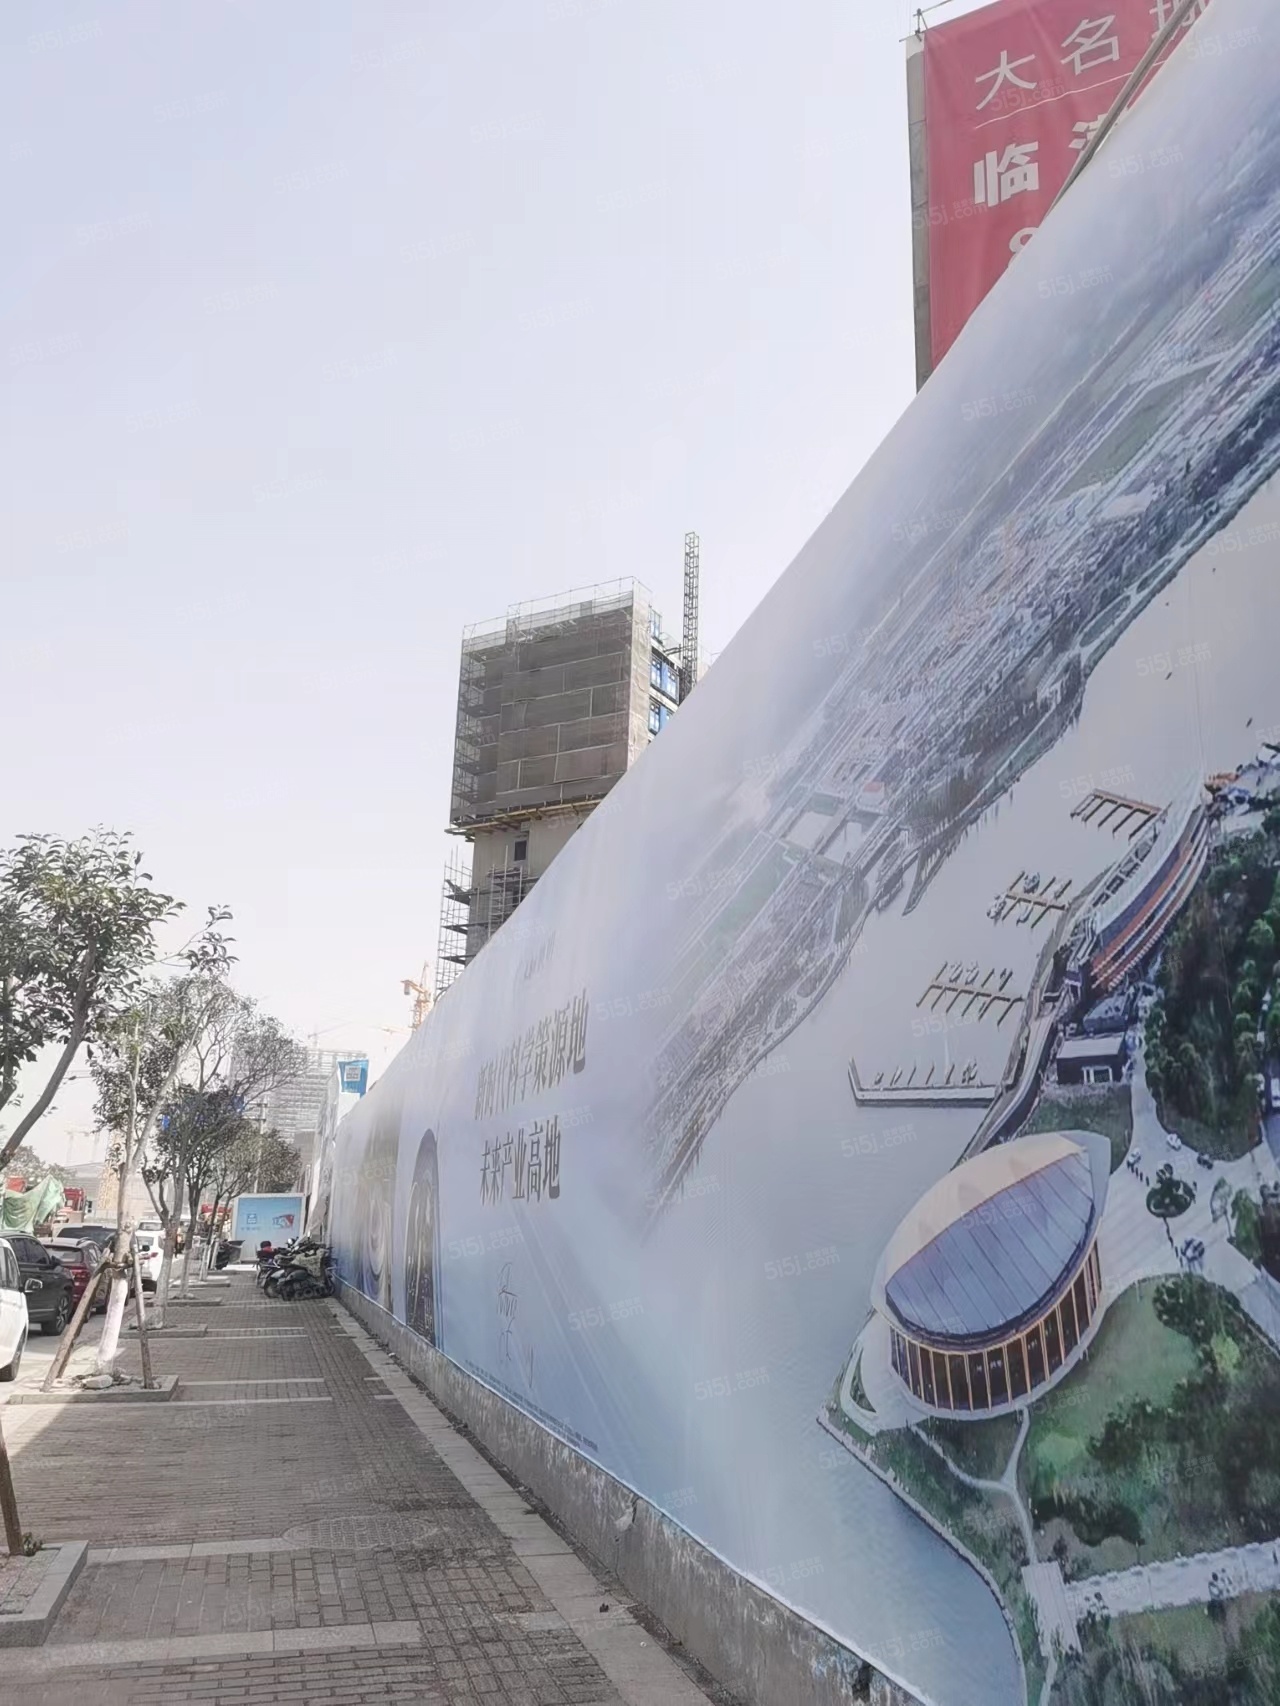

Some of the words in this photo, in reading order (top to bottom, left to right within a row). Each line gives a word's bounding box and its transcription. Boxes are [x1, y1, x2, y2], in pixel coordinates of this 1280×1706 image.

[480, 1113, 562, 1206] 未来产业高地
